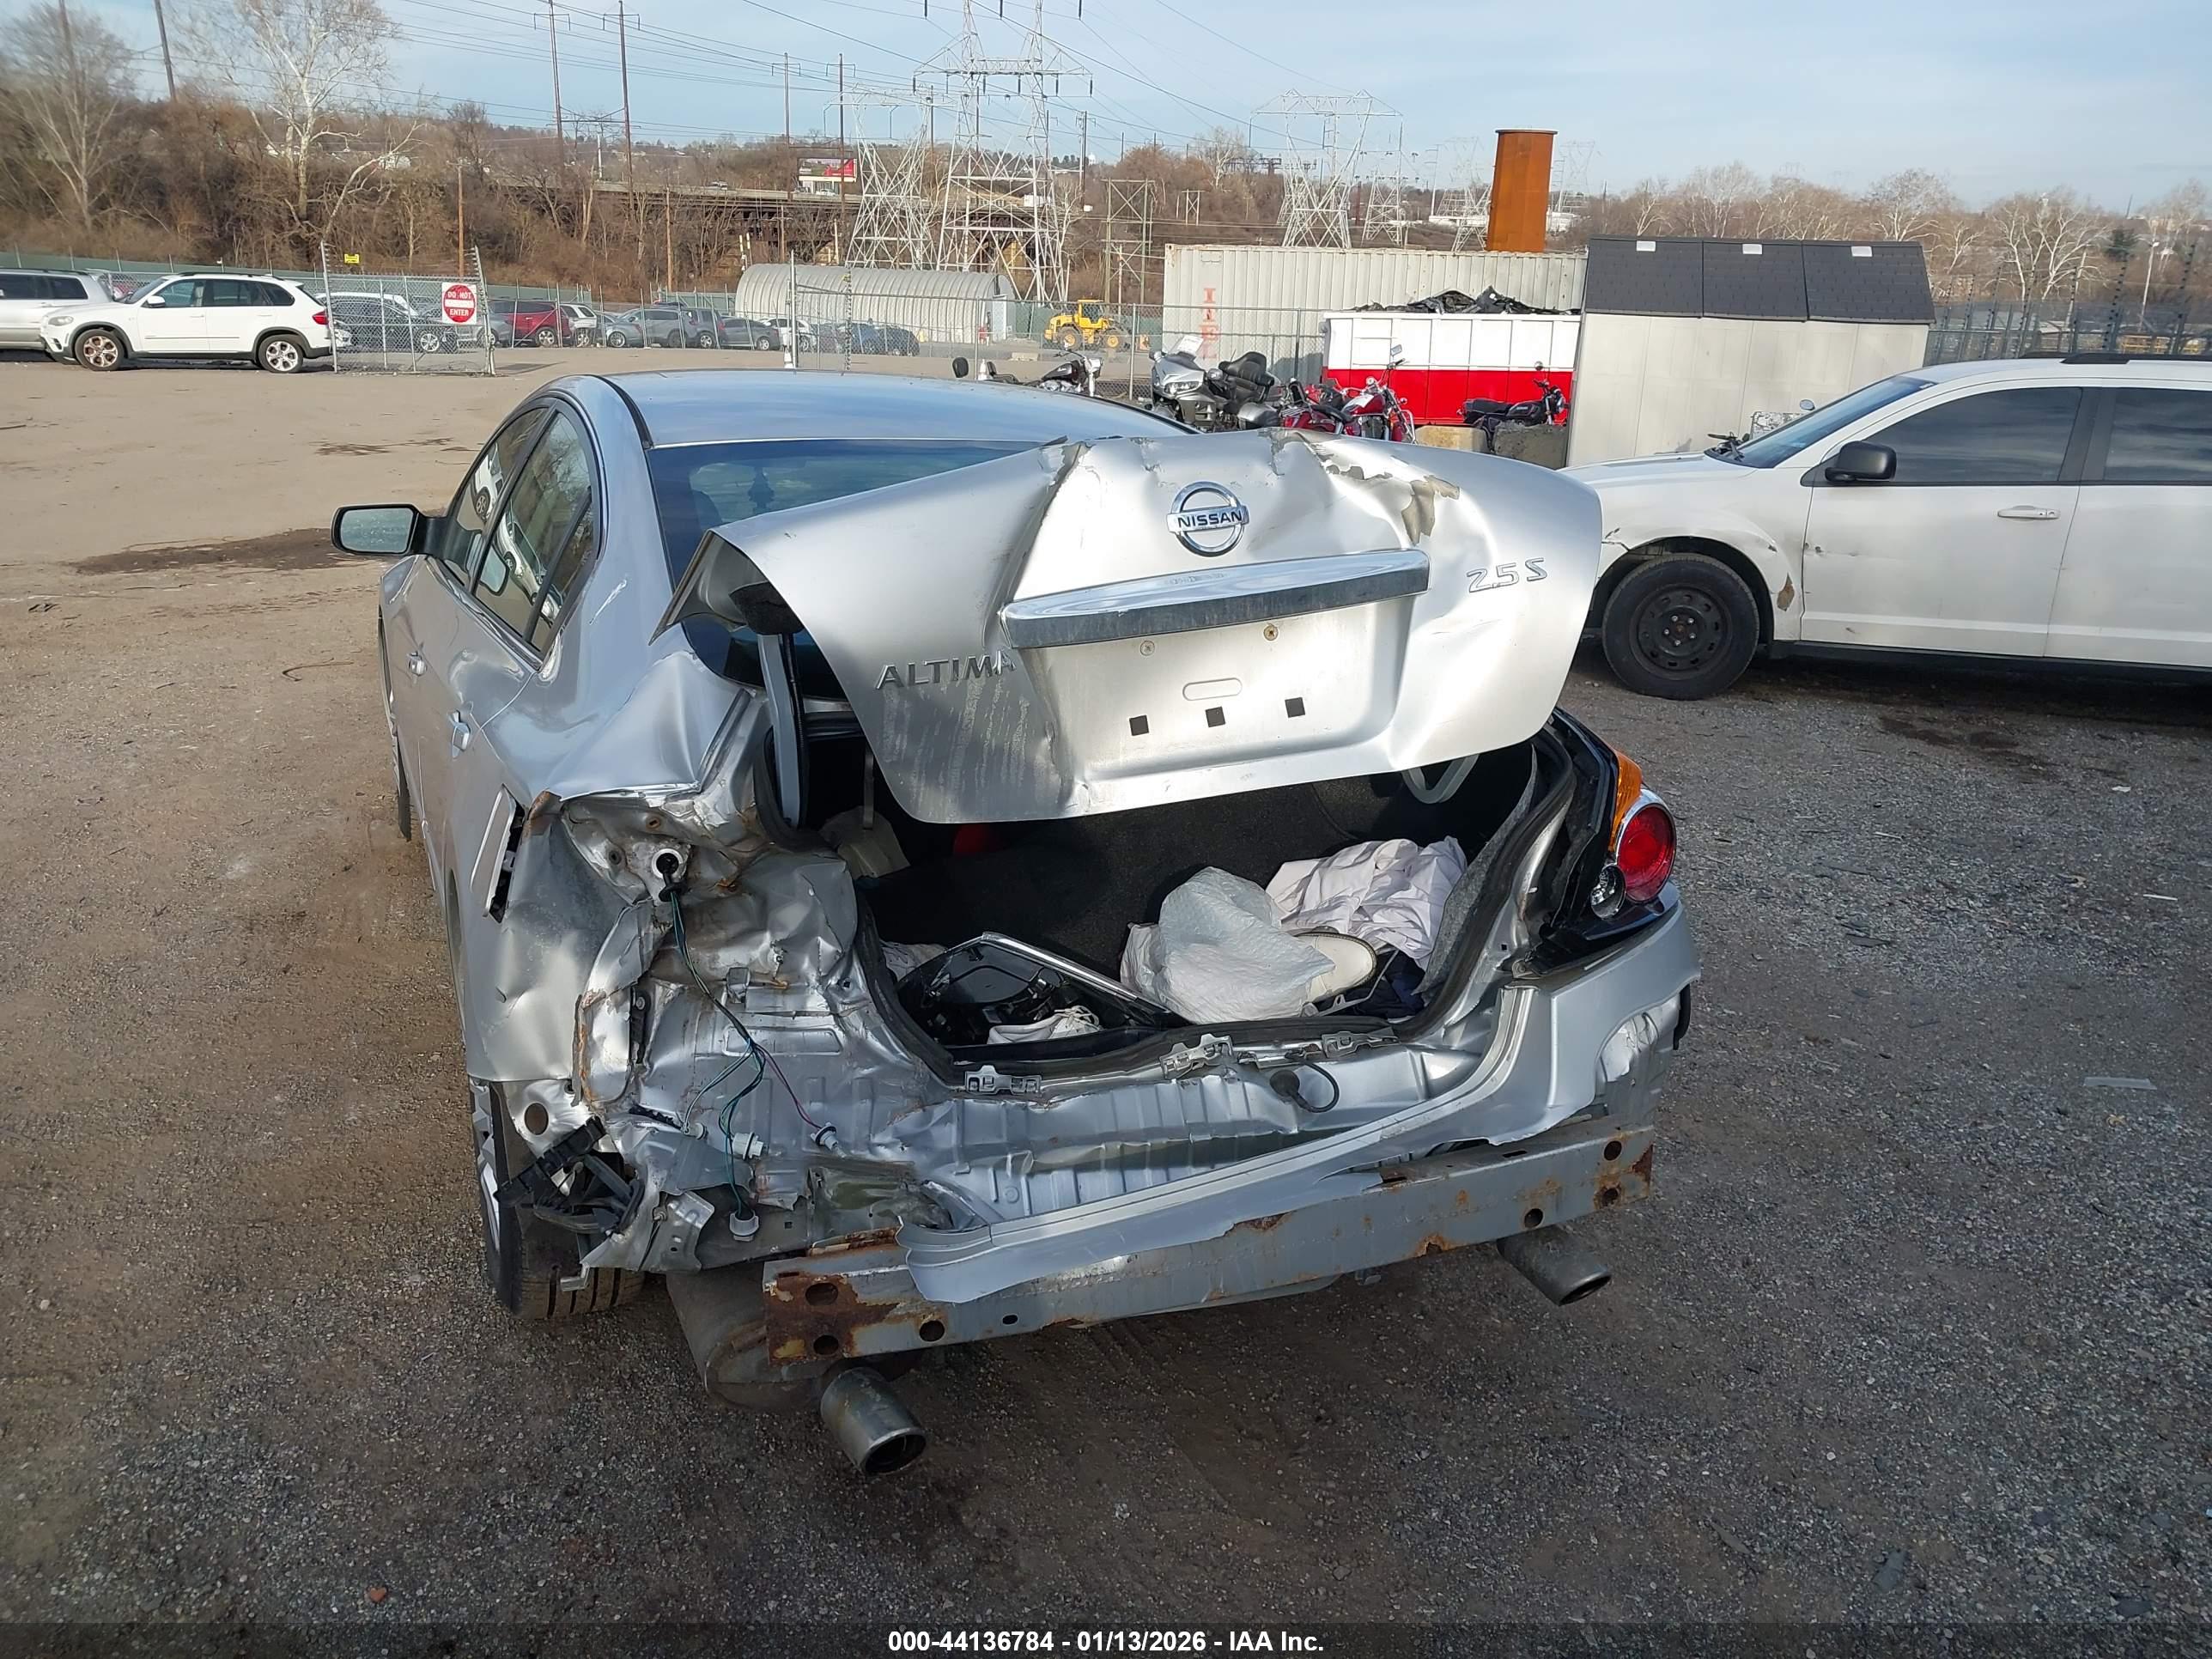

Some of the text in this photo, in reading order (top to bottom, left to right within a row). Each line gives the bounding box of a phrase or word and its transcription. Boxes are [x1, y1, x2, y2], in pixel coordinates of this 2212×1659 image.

[449, 308, 470, 317] ENTER
[1177, 510, 1243, 528] NISSAN
[1524, 557, 1548, 582] S
[875, 649, 1017, 690] ALTIMA
